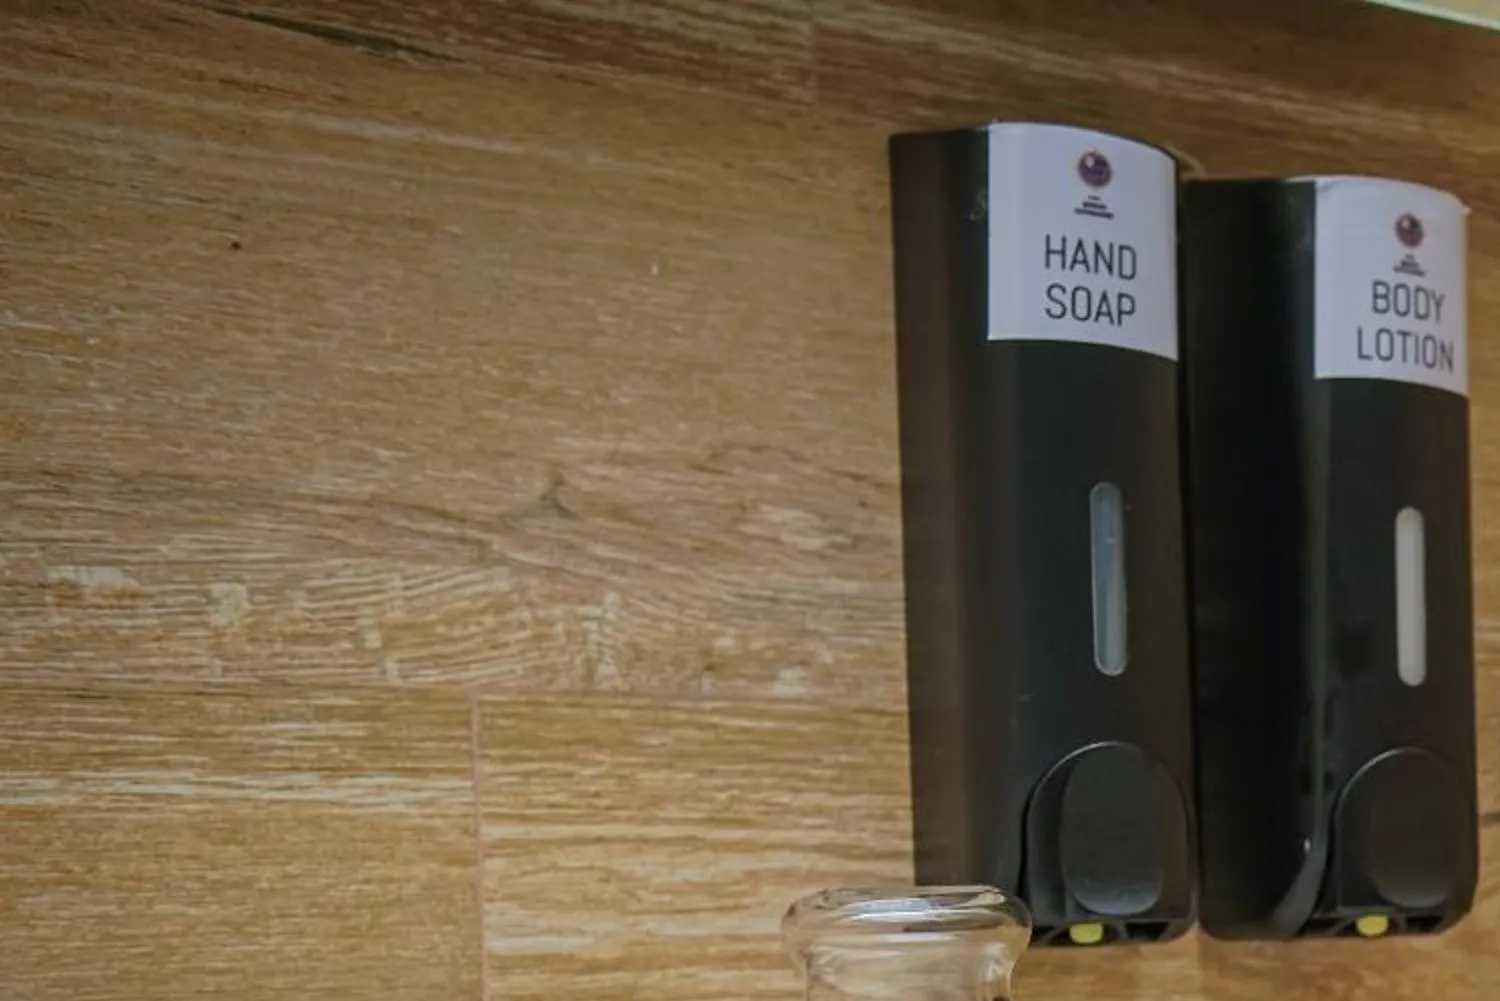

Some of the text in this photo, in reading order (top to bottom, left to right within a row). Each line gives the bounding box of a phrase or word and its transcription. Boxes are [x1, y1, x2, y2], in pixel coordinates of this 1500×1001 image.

[1045, 234, 1137, 281] HAND
[1044, 283, 1135, 328] SOAP
[1372, 280, 1446, 324] BODY
[1357, 326, 1454, 374] LOTION
